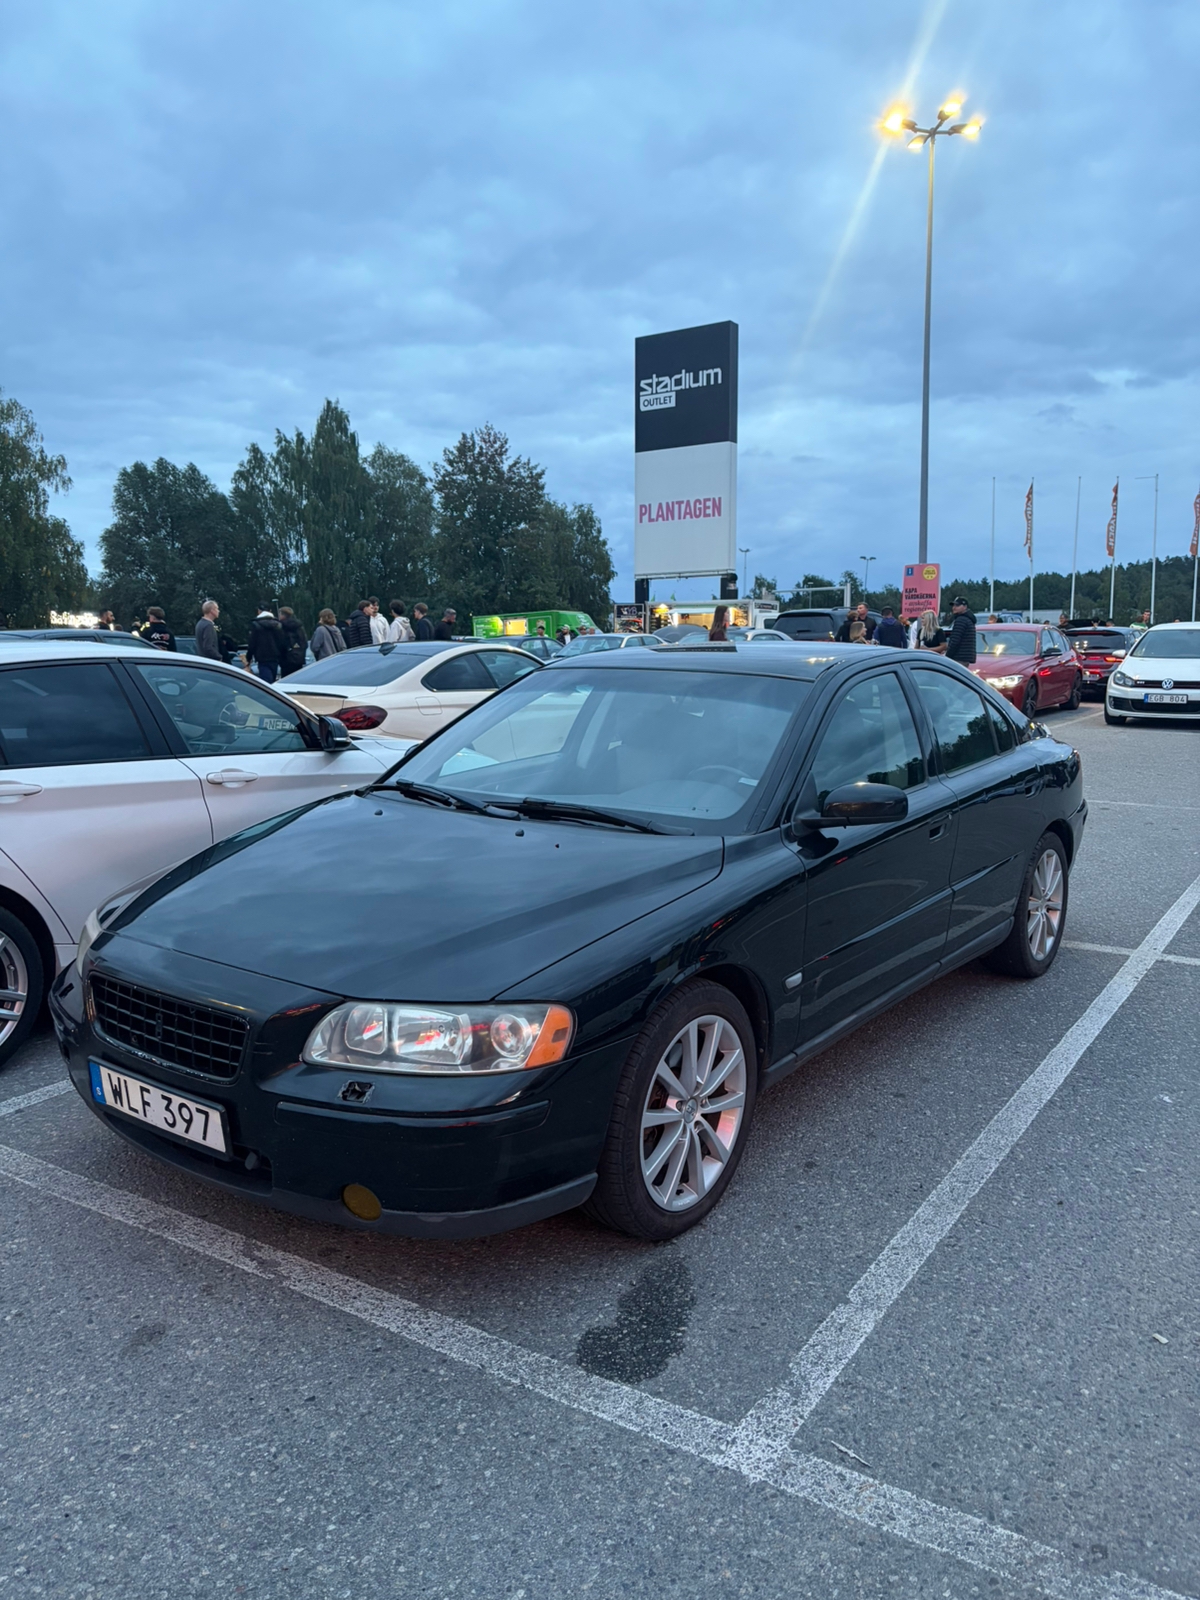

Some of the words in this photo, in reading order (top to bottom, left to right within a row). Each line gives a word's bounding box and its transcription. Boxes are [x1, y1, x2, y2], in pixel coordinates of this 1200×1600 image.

[640, 367, 722, 396] stadium
[643, 395, 673, 407] OUTLET
[639, 497, 722, 523] PLANTAGEN
[108, 1073, 151, 1118] WLF
[161, 1094, 210, 1141] 397
